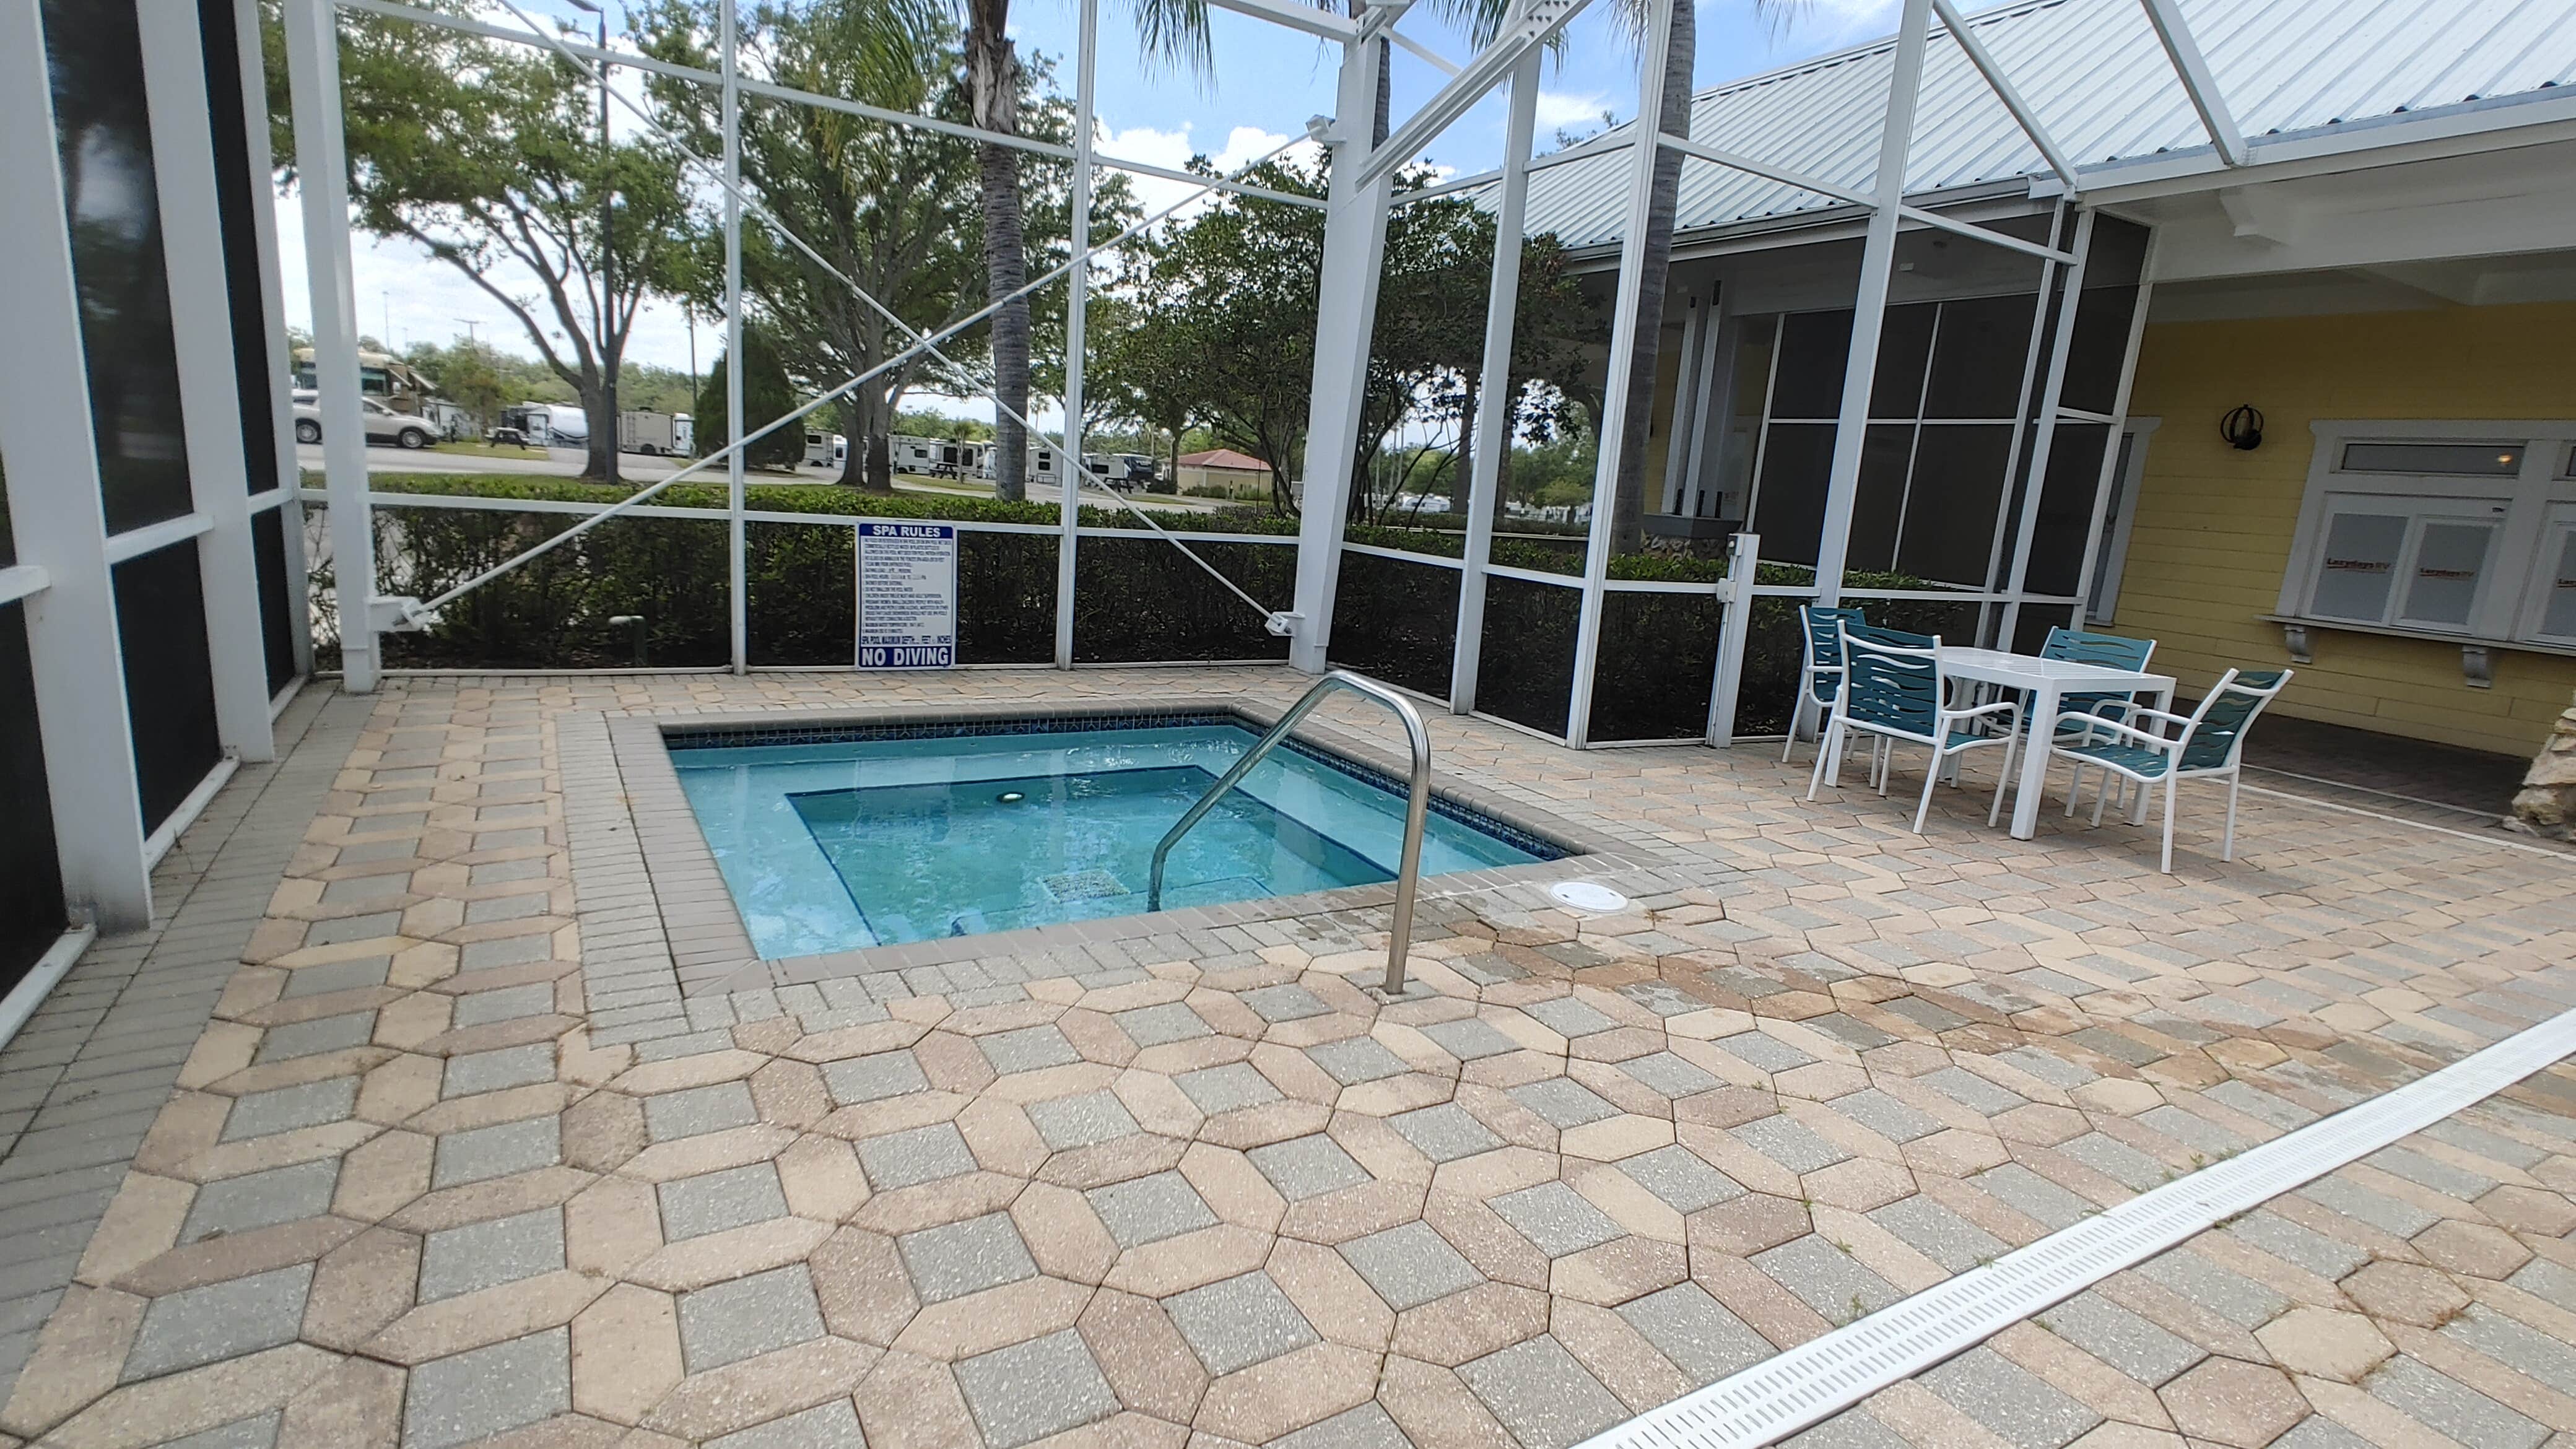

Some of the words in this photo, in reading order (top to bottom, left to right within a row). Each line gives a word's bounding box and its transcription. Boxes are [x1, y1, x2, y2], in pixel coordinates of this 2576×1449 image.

[872, 525, 898, 536] SPA
[901, 526, 941, 537] RULES
[861, 648, 886, 666] NO
[894, 647, 949, 666] DIVING
